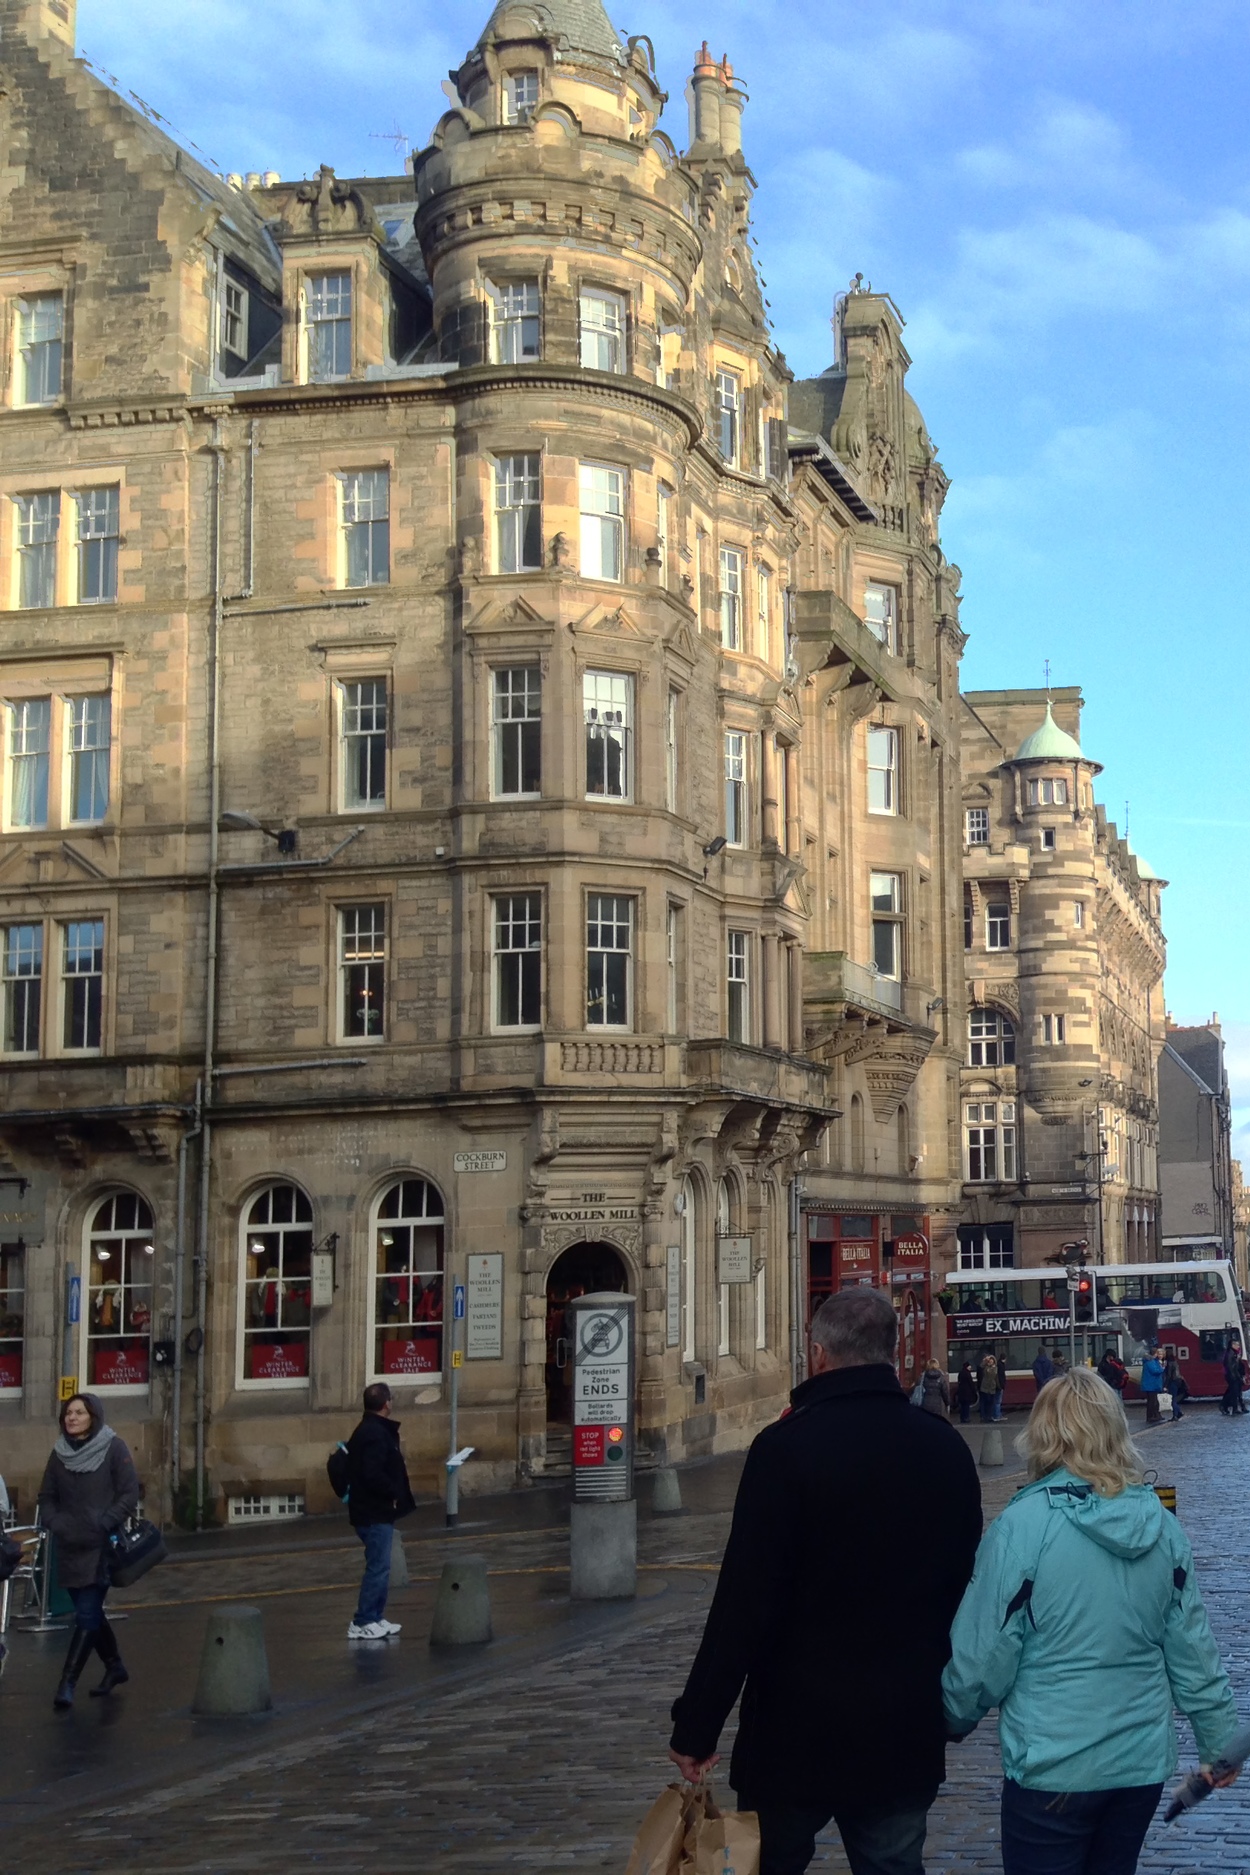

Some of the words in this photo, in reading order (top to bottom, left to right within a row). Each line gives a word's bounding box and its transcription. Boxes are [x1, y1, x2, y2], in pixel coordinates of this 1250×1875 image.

[456, 1153, 504, 1162] COCKBURN
[464, 1162, 494, 1170] STREET
[582, 1193, 605, 1203] THE
[550, 1210, 604, 1221] WOOLLEN
[609, 1209, 637, 1220] MILL
[842, 1249, 856, 1261] BELLA
[390, 1361, 432, 1369] CLEARANCE
[583, 1384, 619, 1395] ENDS
